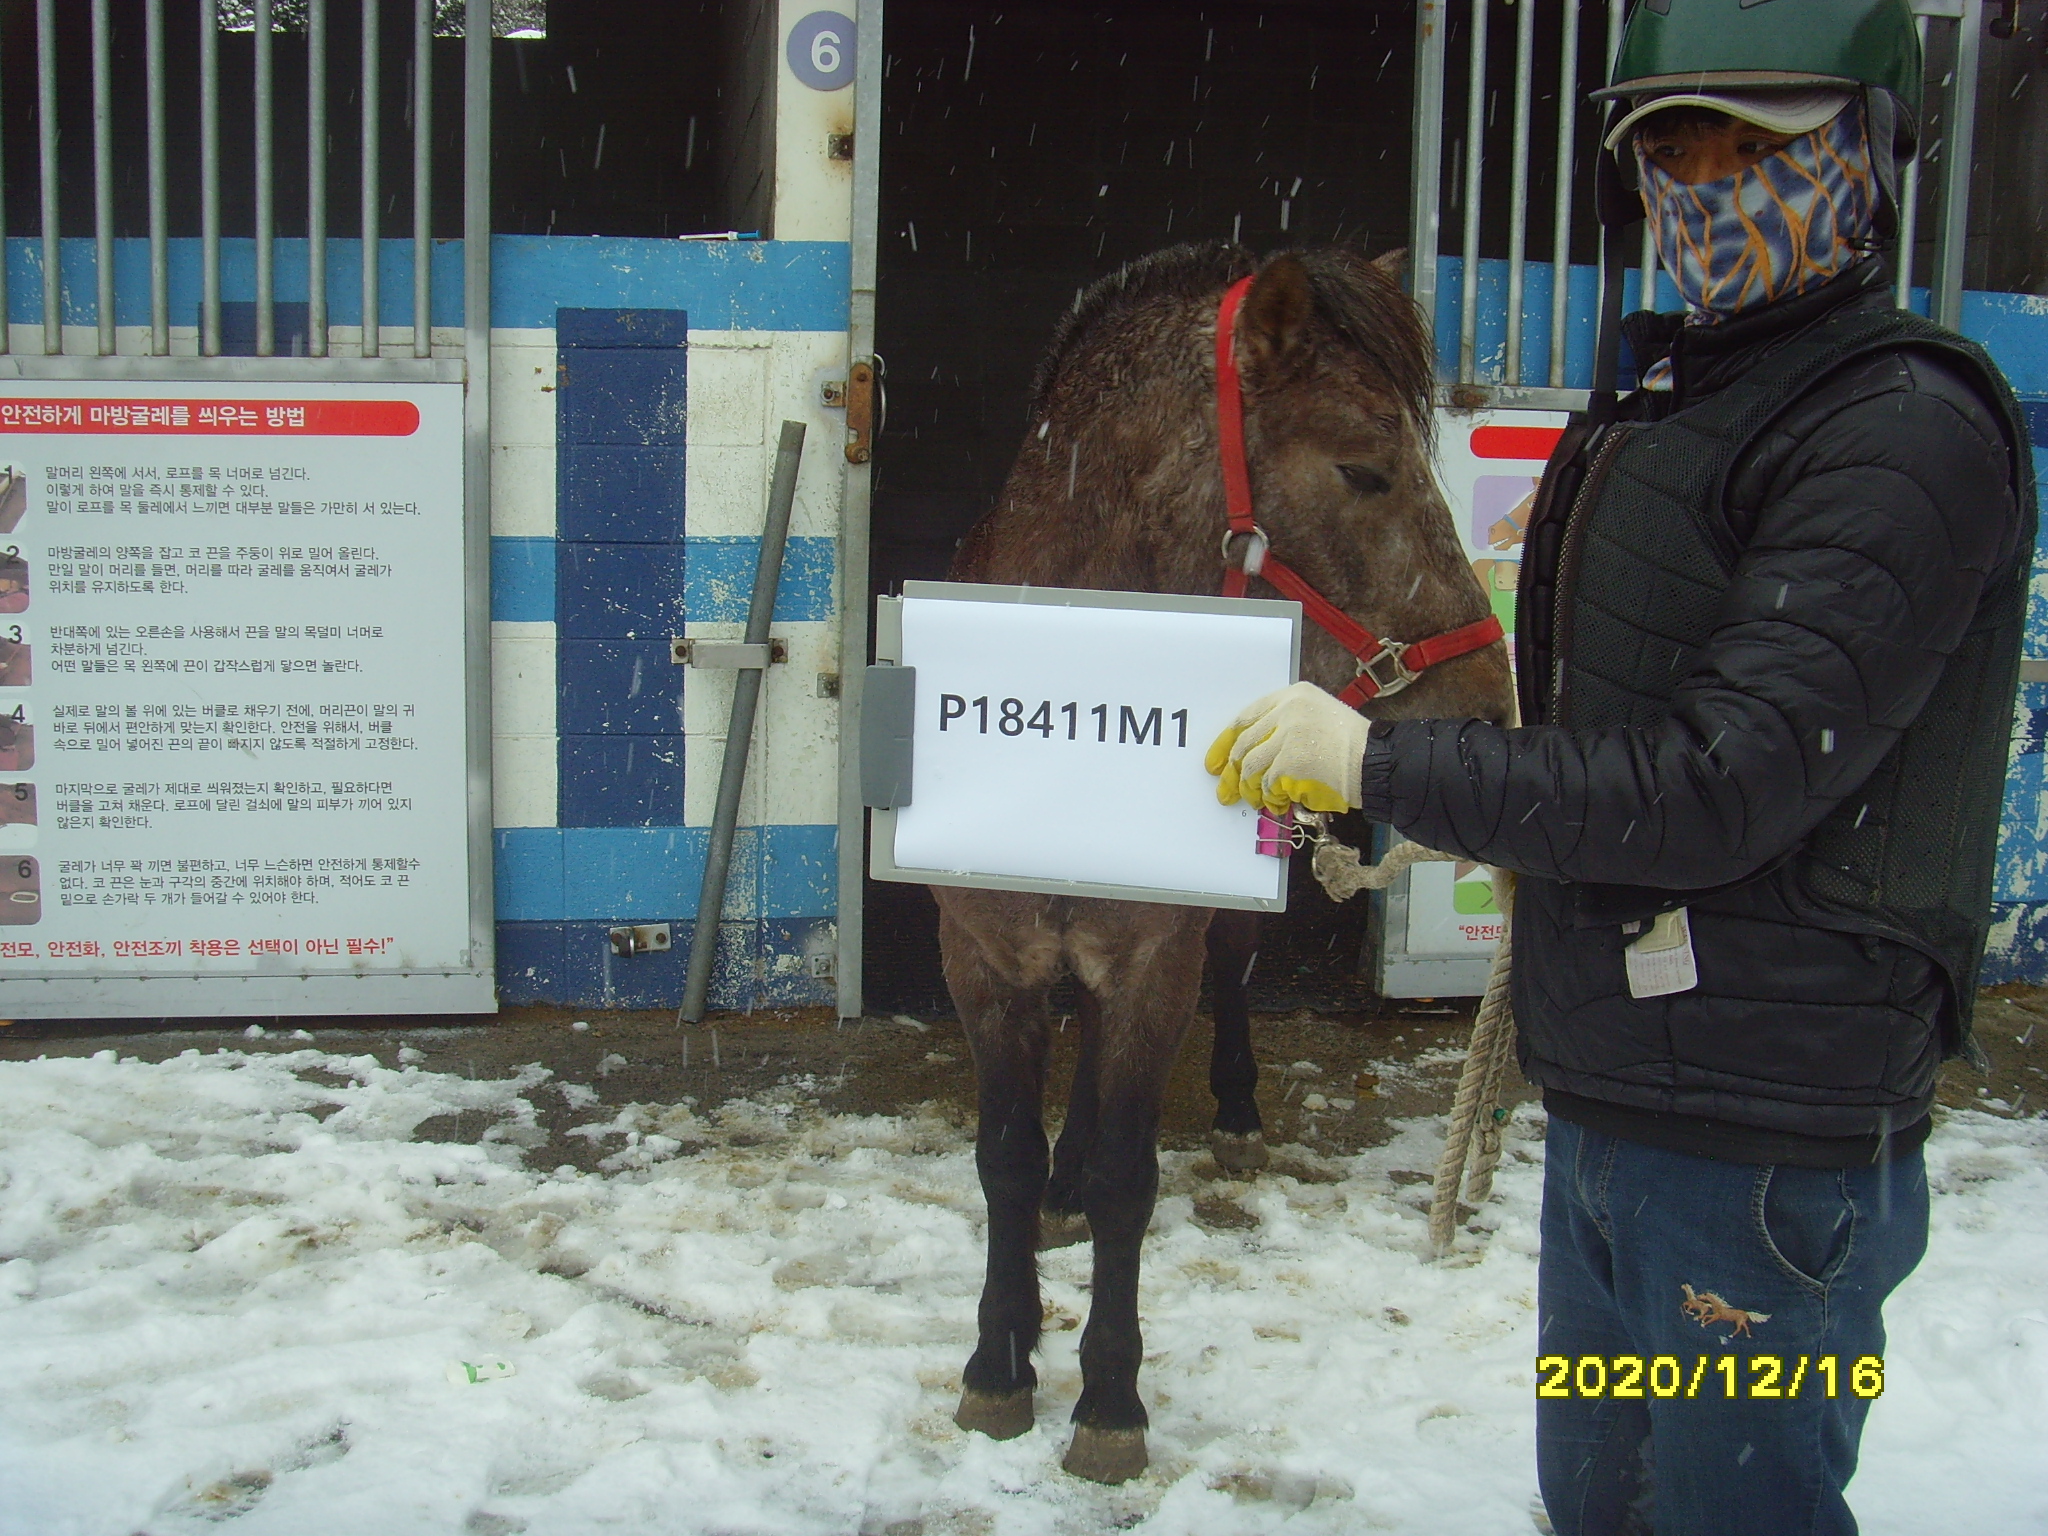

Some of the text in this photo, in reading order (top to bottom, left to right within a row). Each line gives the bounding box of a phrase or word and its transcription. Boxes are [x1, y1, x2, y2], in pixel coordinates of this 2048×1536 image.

[811, 30, 841, 73] 6
[2, 405, 304, 427] 안전하게 마방굴레를 씌우는 방법
[4, 465, 12, 484] 1
[46, 466, 309, 480] 말머리 왼쪽에 서서, 로프를 목 너머로 넘긴다.
[47, 483, 268, 498] 이렇게 하여 말을 즉시 통제할 수 있다.
[47, 500, 420, 515] 말이 로프를 목 둘레에서 느끼면 대부분 말들은 가만히 서 있는다.
[7, 545, 20, 563] 2
[48, 546, 378, 560] 마방굴레의 양쪽을 잡고 코 끈을 주둥이 위로 밀어 올린다.
[49, 563, 392, 577] 만일 말이 머리를 들면, 머리를 따라 굴레를 움직여서 굴레가
[49, 580, 188, 593] 위치를 유지하도록 한다.
[9, 625, 22, 644] 3
[50, 626, 384, 639] 반대쪽에 있는 오른손을 사용해서 끈을 말의 목덜미 너머로
[51, 642, 147, 656] 차분하게 넘긴다.
[52, 659, 363, 673] 어떤 말들은 목 왼쪽에 끈이 갑작스럽게 닿으면 놀란다.
[11, 704, 25, 722] 4
[53, 704, 414, 718] 실제로 말의 볼 위에 있는 버클로 채우기 전에, 머리끈이 말의 귀
[54, 721, 393, 734] 바로 뒤에서 편안하게 맞는지 확인한다. 안전을 위해서, 버클
[939, 693, 1188, 748] P18411M1
[54, 737, 418, 751] 속으로 밀어 넣어진 끈의 끝이 빠지지 않도록 적절하게 고정한다.
[15, 783, 28, 801] 5
[56, 781, 392, 796] 마지막으로 굴레가 제대로 씌워졌는지 확인하고, 필요하다면
[57, 798, 411, 812] 버클을 고쳐 채운다. 로프에 달린 걸쇠에 말의 피부가 끼어 있지
[1241, 809, 1247, 817] 6
[57, 816, 152, 829] 않은지 확인한다.
[18, 860, 31, 878] 6
[58, 858, 420, 873] 굴레가 너무 꽉 끼면 불편하고, 너무 느슨하면 안전하게 통제할수
[60, 875, 409, 889] 없다. 코 끈은 눈과 구각의 중간에 위치해야 하며, 적어도 코 끈
[61, 891, 318, 906] 밑으로 손가락 두 개가 들어갈 수 있어야 한다.
[48, 941, 105, 958] 안전화,
[114, 940, 181, 956] 안전조끼
[190, 940, 240, 957] 착용은
[248, 939, 297, 955] 선택이
[306, 939, 338, 955] 아닌
[347, 937, 393, 954] 필수!”
